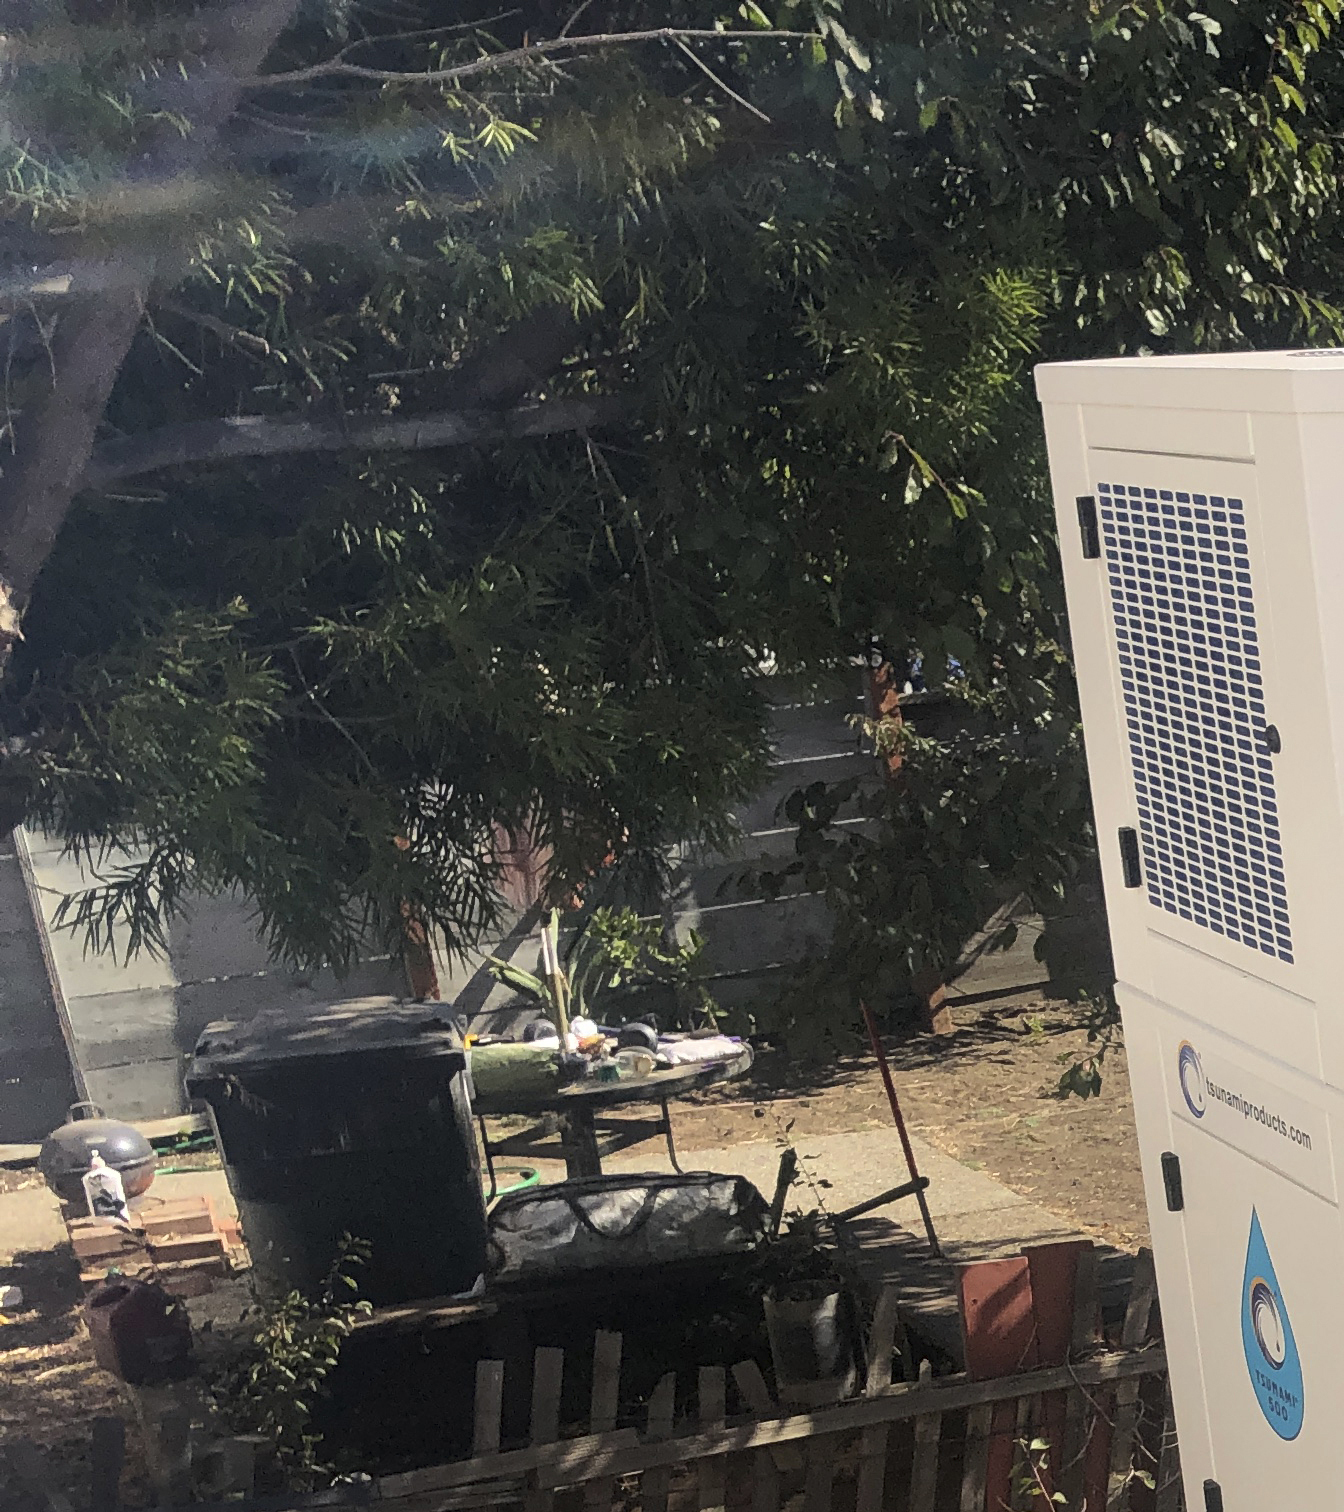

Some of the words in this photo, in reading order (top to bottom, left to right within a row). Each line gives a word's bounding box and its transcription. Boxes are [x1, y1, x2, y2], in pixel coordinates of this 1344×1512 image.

[1206, 1077, 1312, 1151] tsunamiproducts.com
[1255, 1369, 1296, 1408] TSUNAMI
[1268, 1396, 1288, 1421] 500
